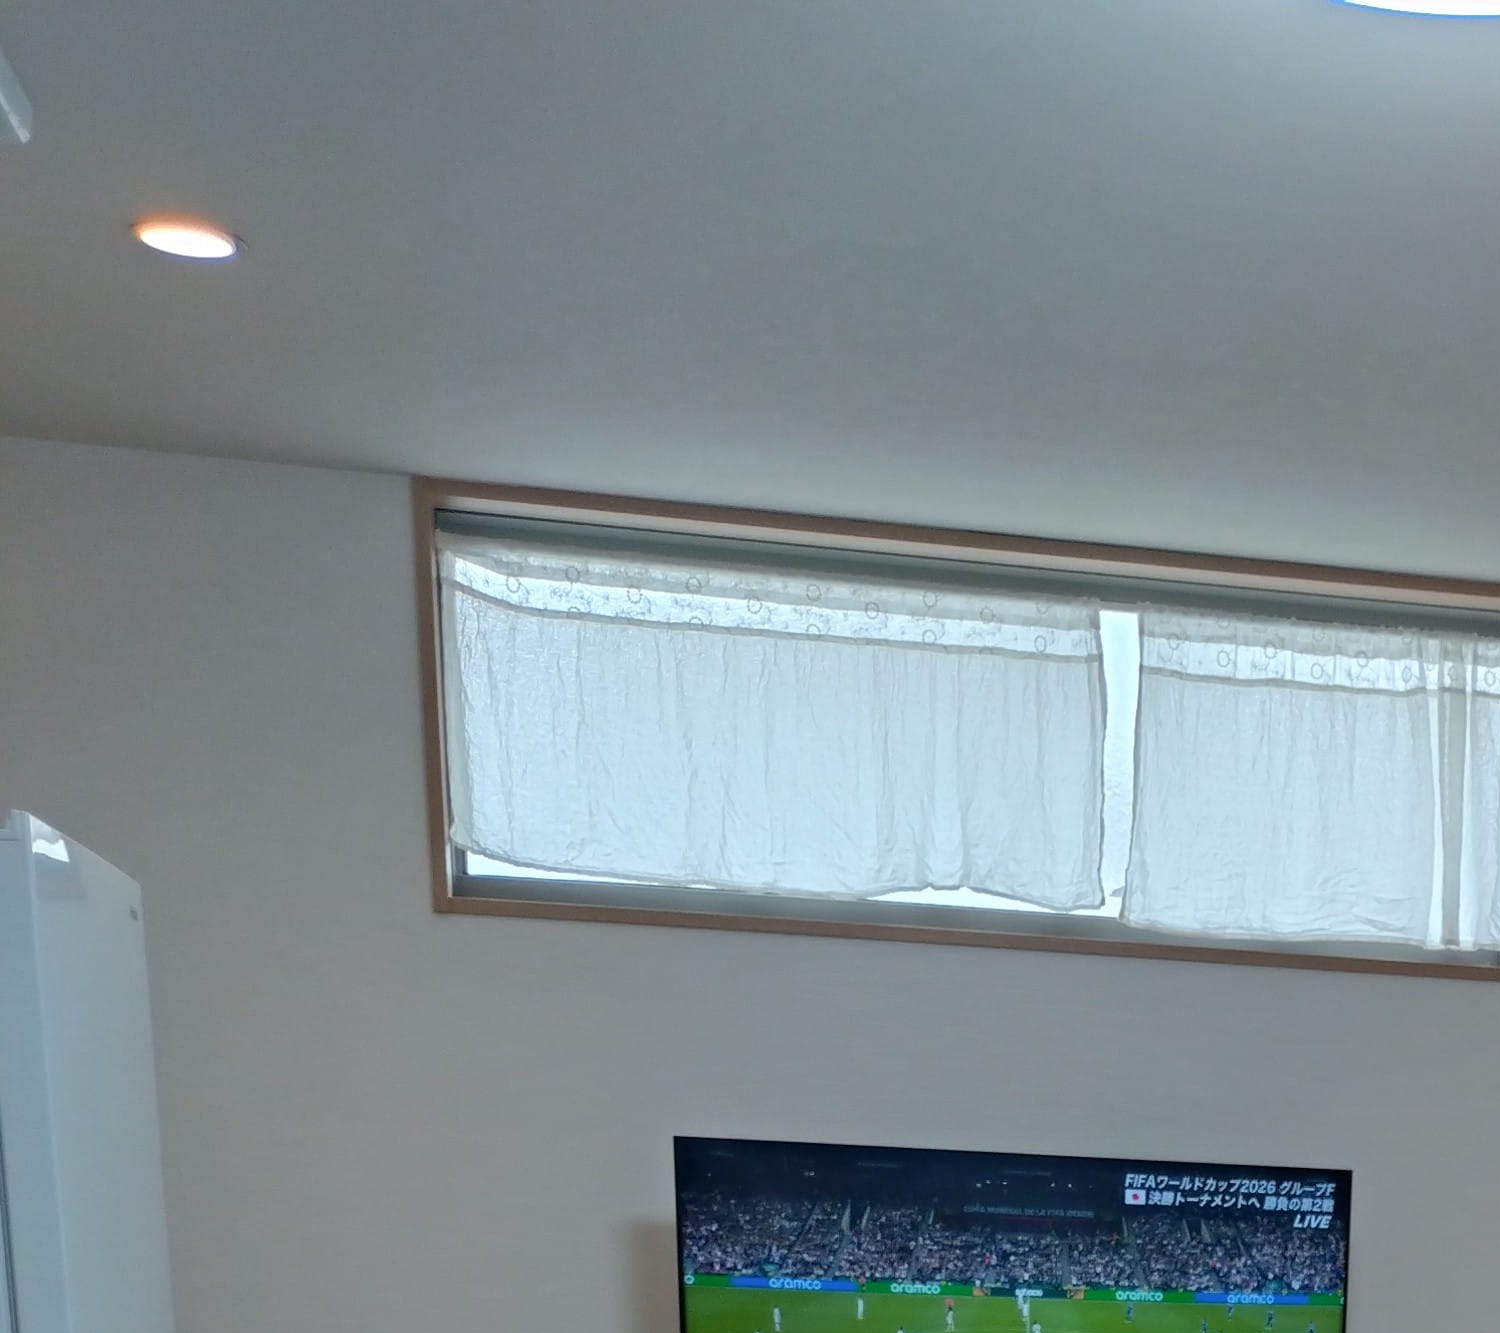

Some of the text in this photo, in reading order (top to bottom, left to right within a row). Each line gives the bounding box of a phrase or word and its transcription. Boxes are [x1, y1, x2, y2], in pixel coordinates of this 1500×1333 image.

[1125, 1173, 1277, 1194] FIFAワールドカップ2026
[1148, 1191, 1260, 1208] 決勝トーナメントへ
[1293, 1214, 1332, 1229] LIVE
[769, 1277, 822, 1290] aramco
[891, 1281, 941, 1295] aramco
[1115, 1289, 1164, 1302] aramco
[1227, 1292, 1275, 1305] aramco
